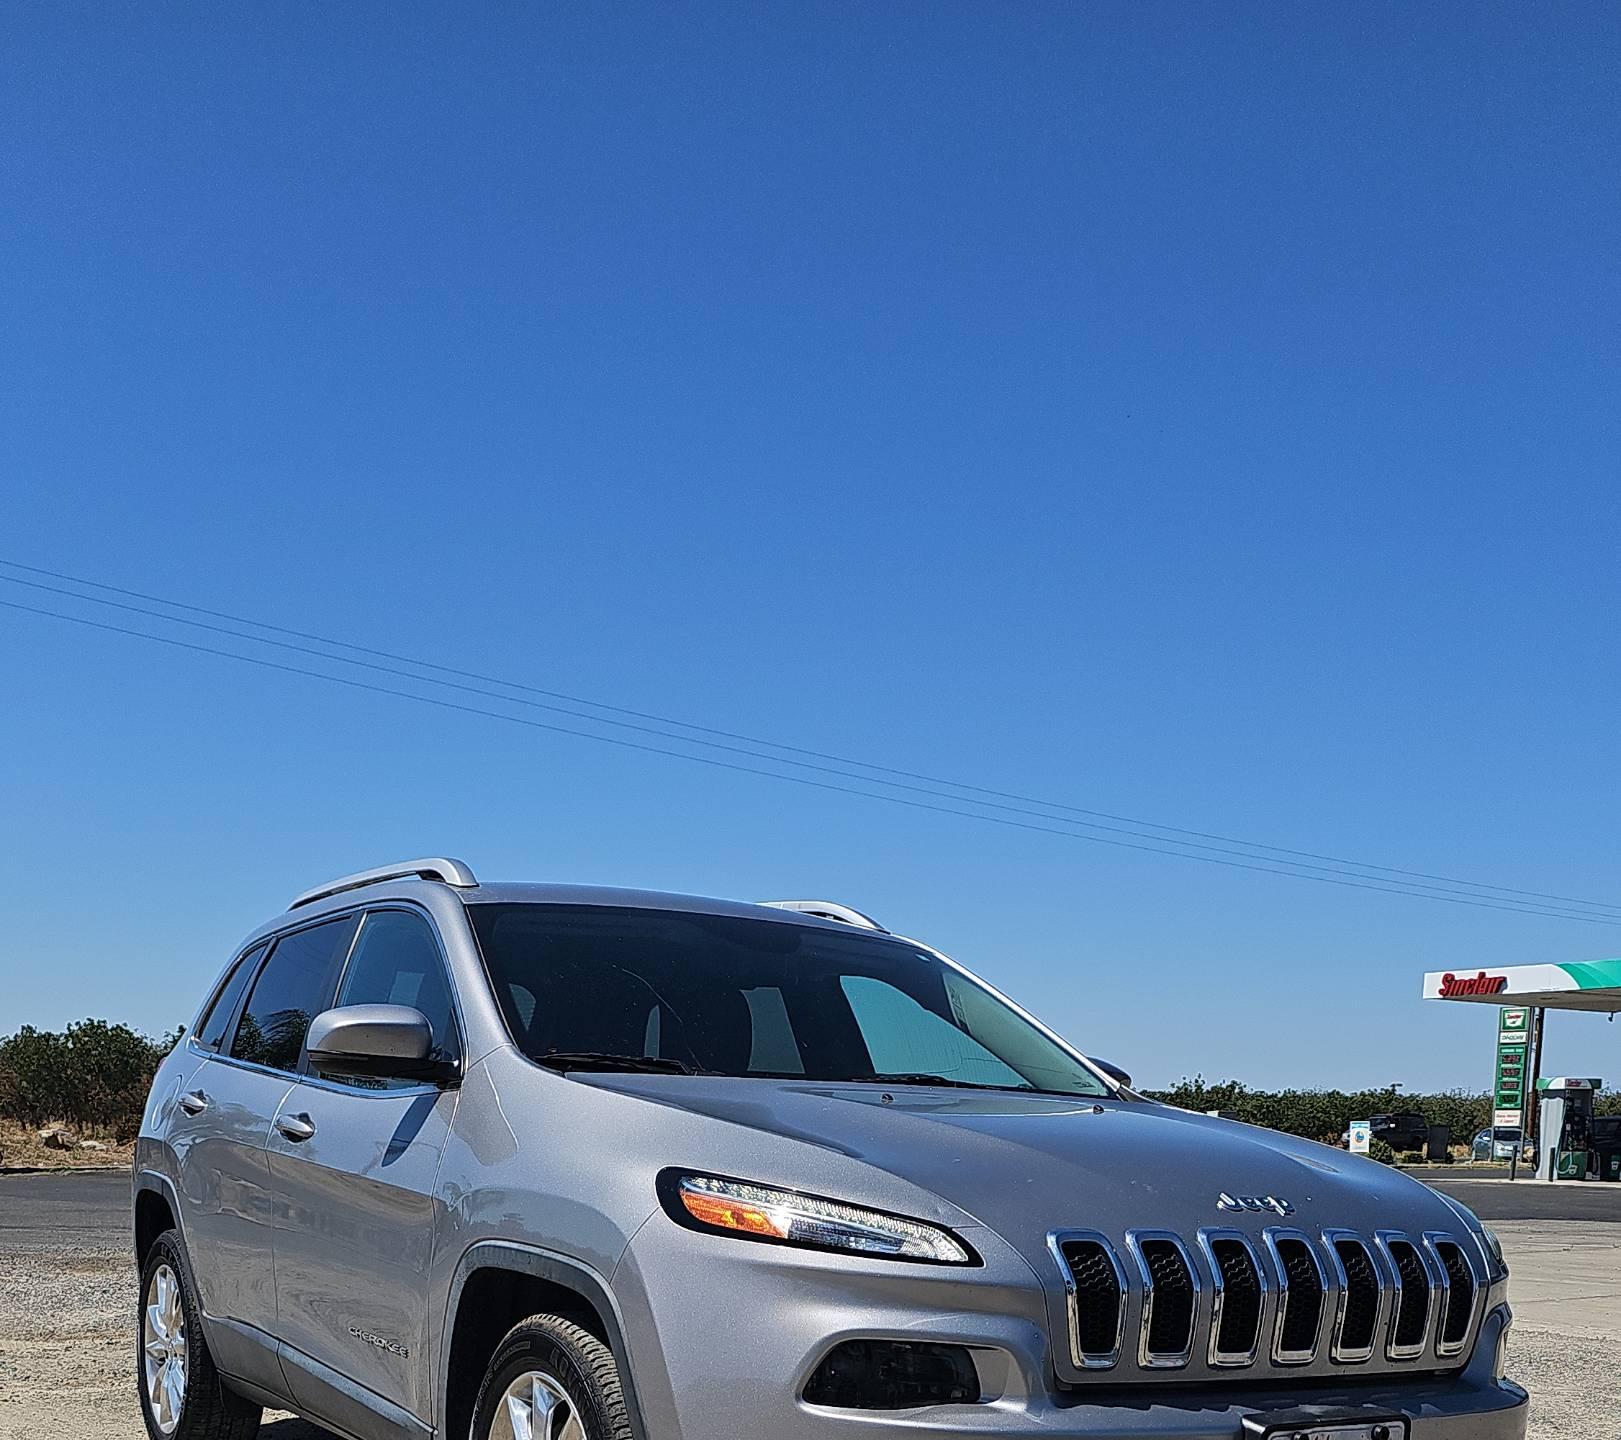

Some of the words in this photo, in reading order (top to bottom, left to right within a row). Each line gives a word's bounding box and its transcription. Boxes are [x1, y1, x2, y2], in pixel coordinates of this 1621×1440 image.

[1438, 971, 1506, 997] Sinclair
[1216, 1192, 1296, 1217] Jeep
[348, 1326, 409, 1359] CHEROKEE
